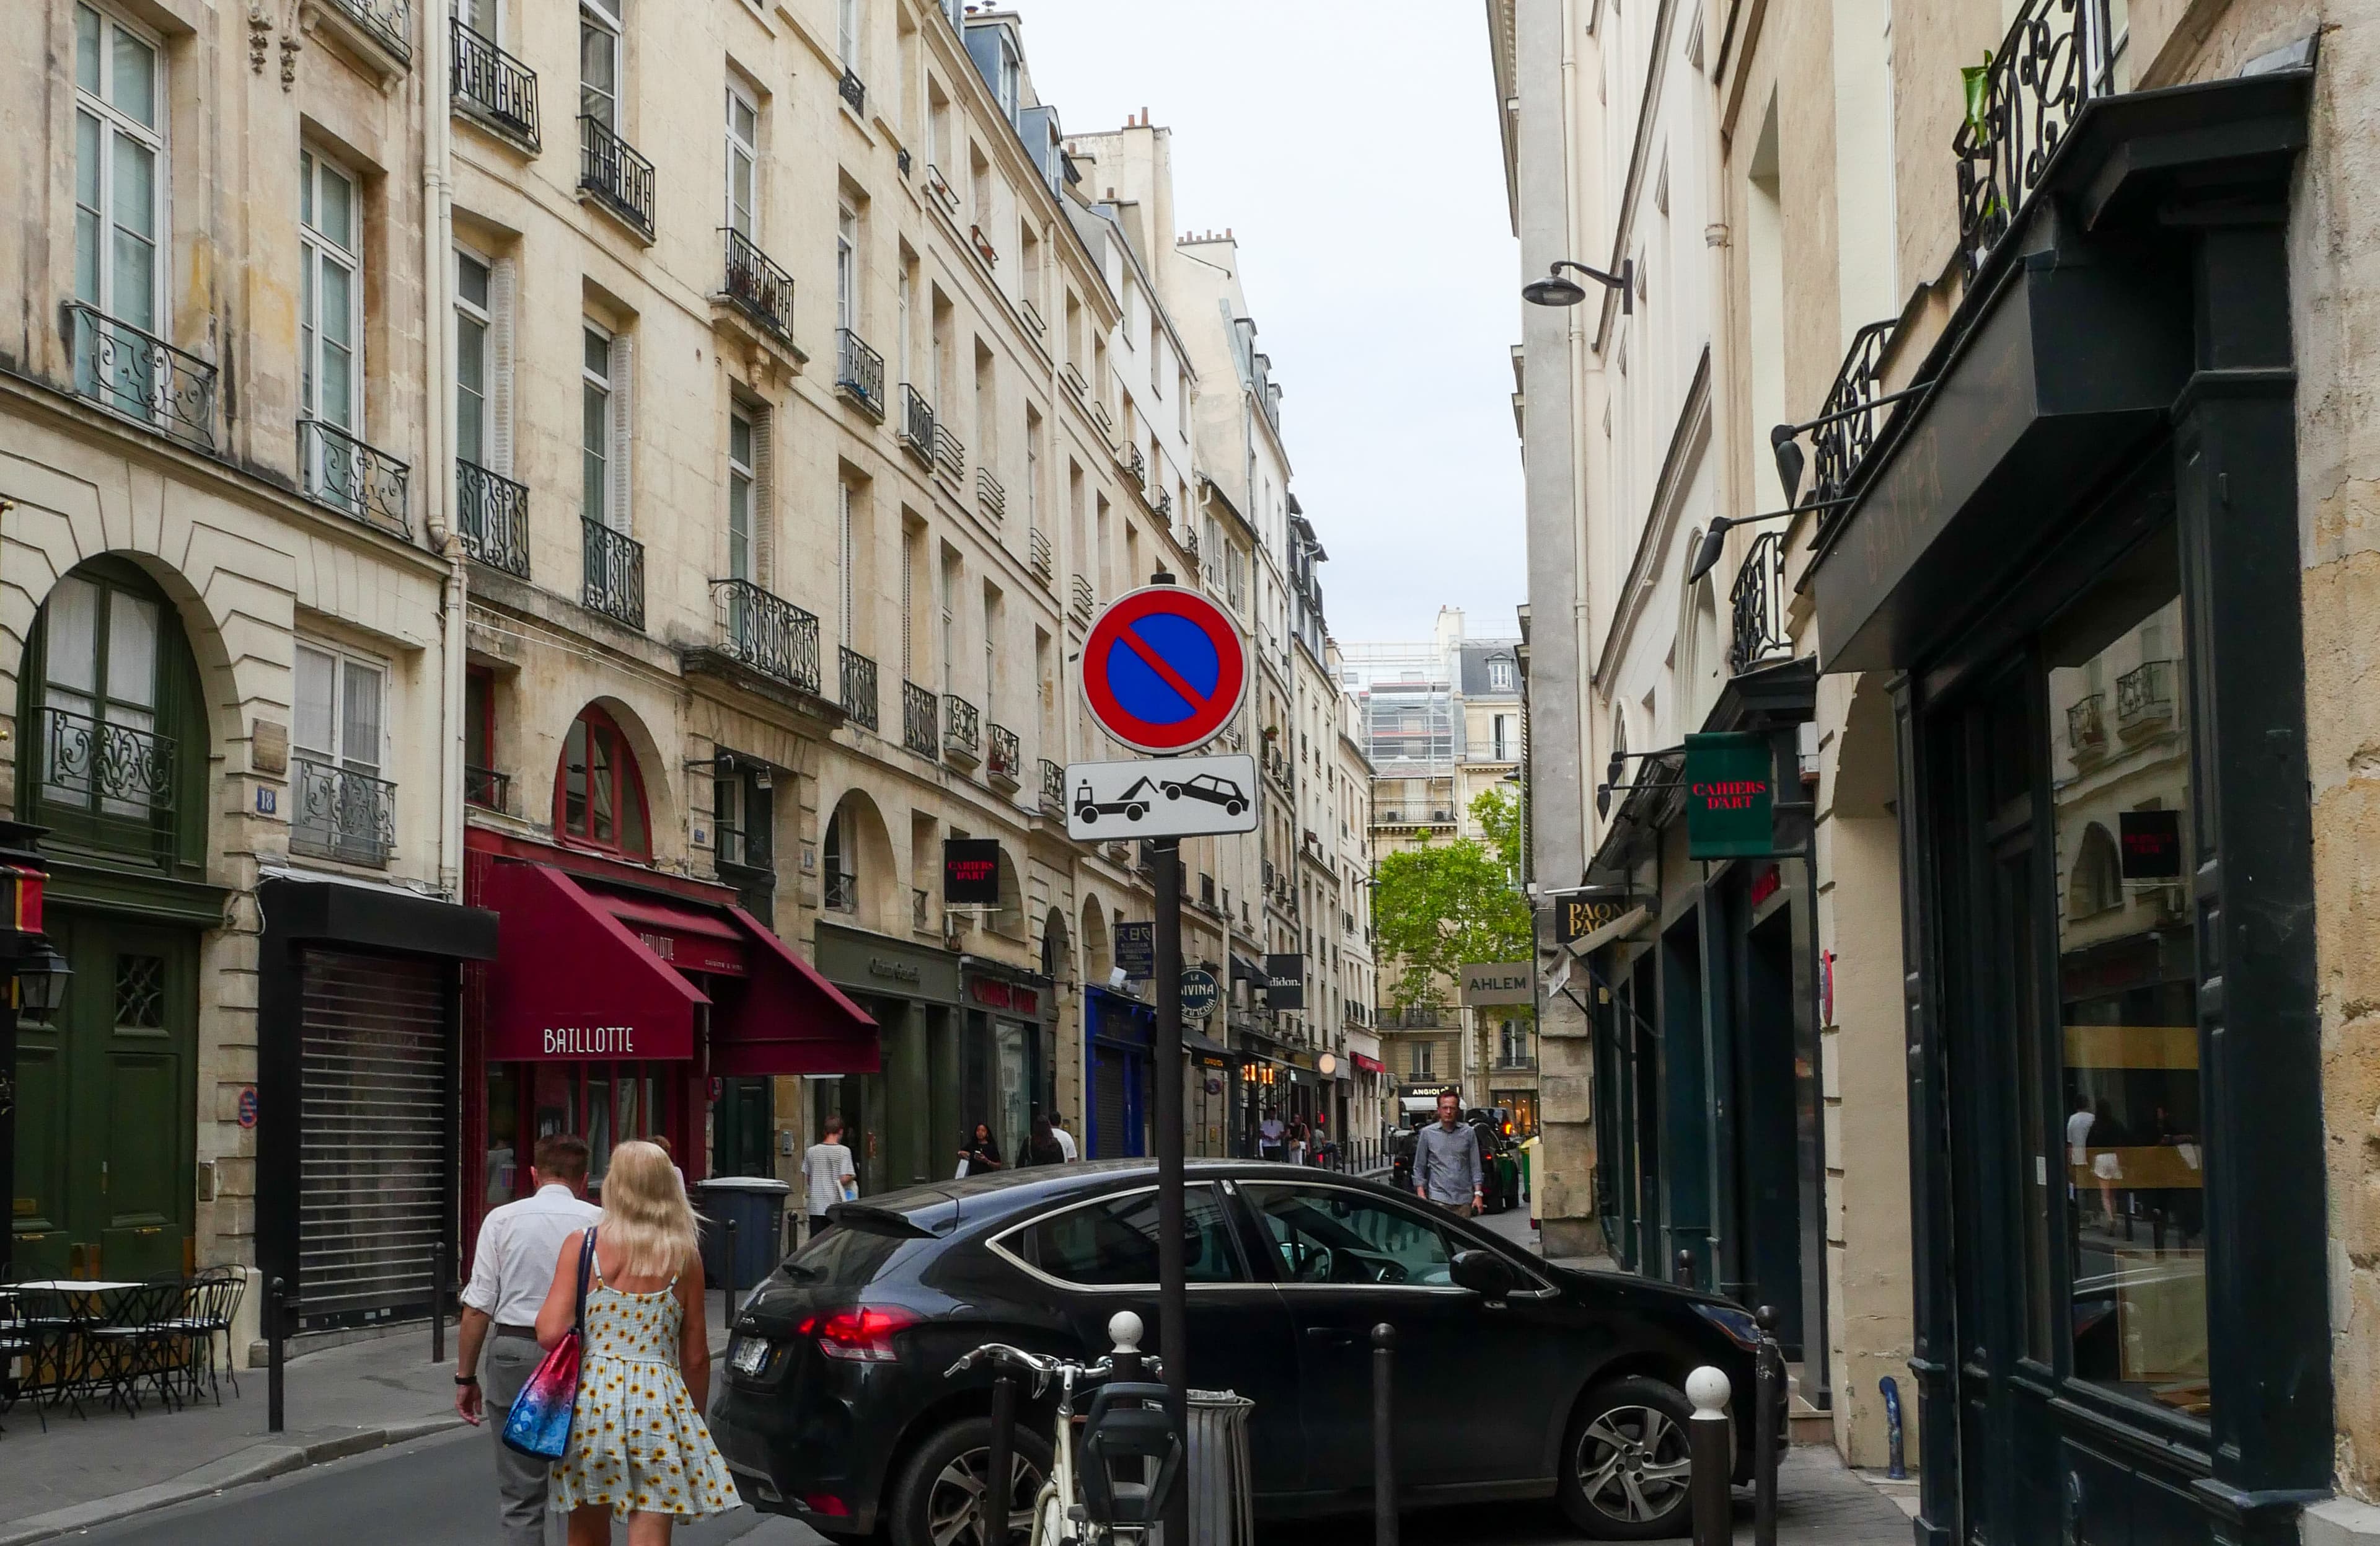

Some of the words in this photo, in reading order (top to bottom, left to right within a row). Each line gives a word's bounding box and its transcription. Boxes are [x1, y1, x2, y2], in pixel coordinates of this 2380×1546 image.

[1692, 781, 1766, 796] CAHIERS
[261, 790, 273, 811] 18
[1707, 795, 1753, 810] D'ART
[1269, 977, 1301, 987] didon.
[1469, 977, 1527, 992] AHLEM
[1181, 984, 1214, 996] IVINA
[544, 1027, 633, 1053] BAILLOTTE
